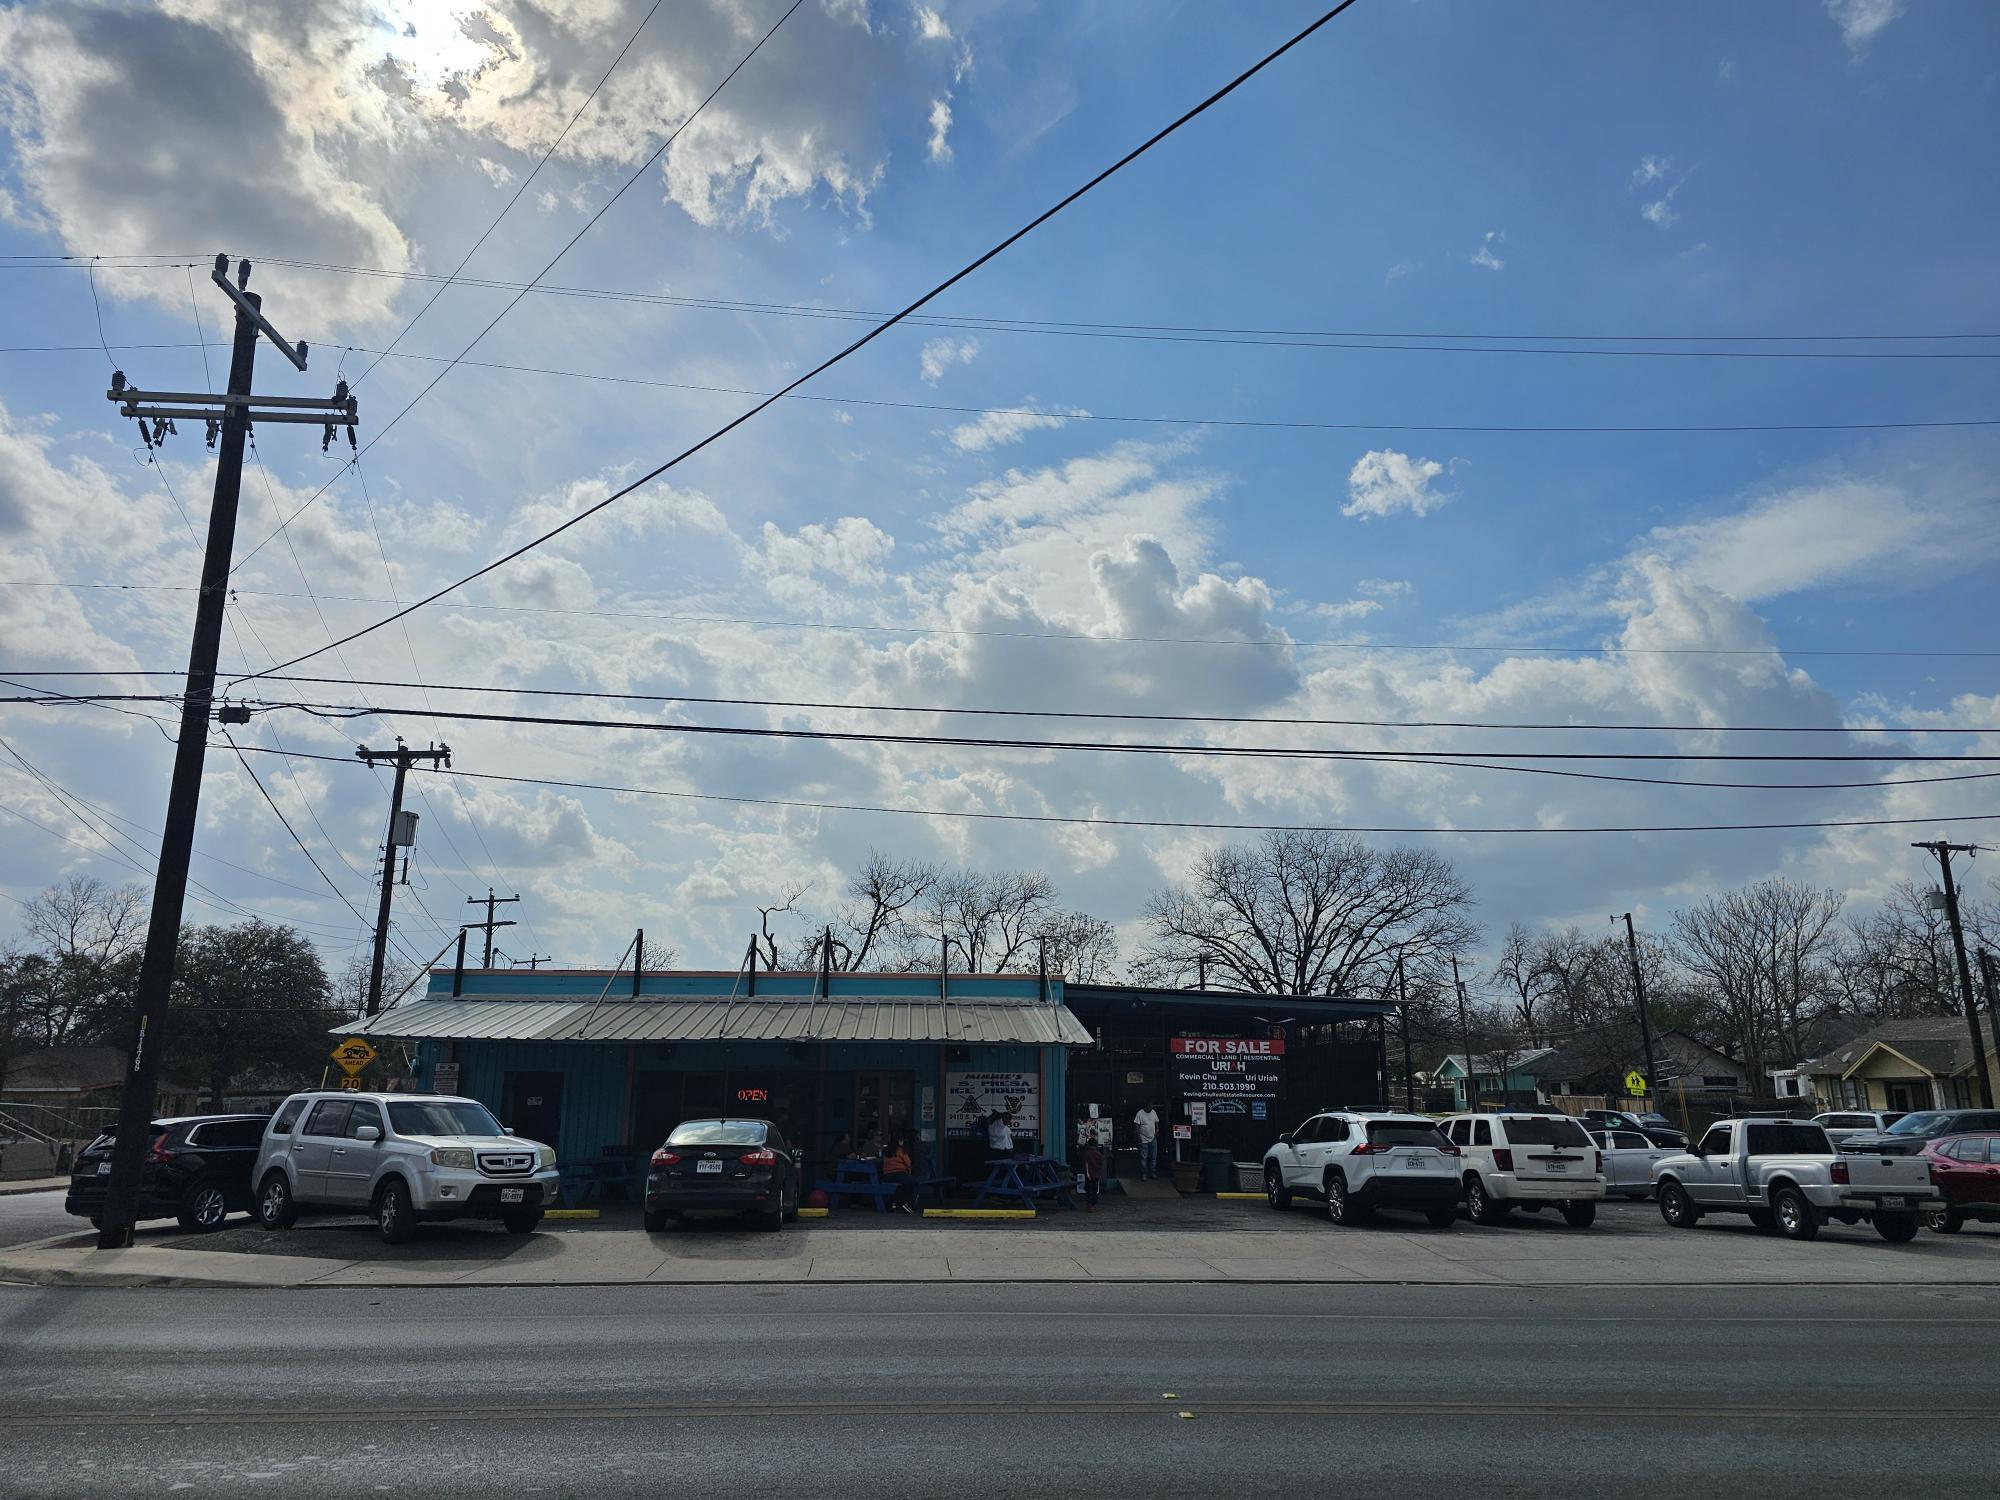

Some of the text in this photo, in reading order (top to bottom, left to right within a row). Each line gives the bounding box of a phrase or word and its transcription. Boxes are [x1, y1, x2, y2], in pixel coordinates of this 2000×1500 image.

[1184, 1040, 1271, 1054] FOR SALE
[1202, 1073, 1217, 1081] Chu
[343, 1080, 359, 1089] 20
[1202, 1083, 1256, 1091] 210.503.1990
[738, 1090, 767, 1101] OPEN
